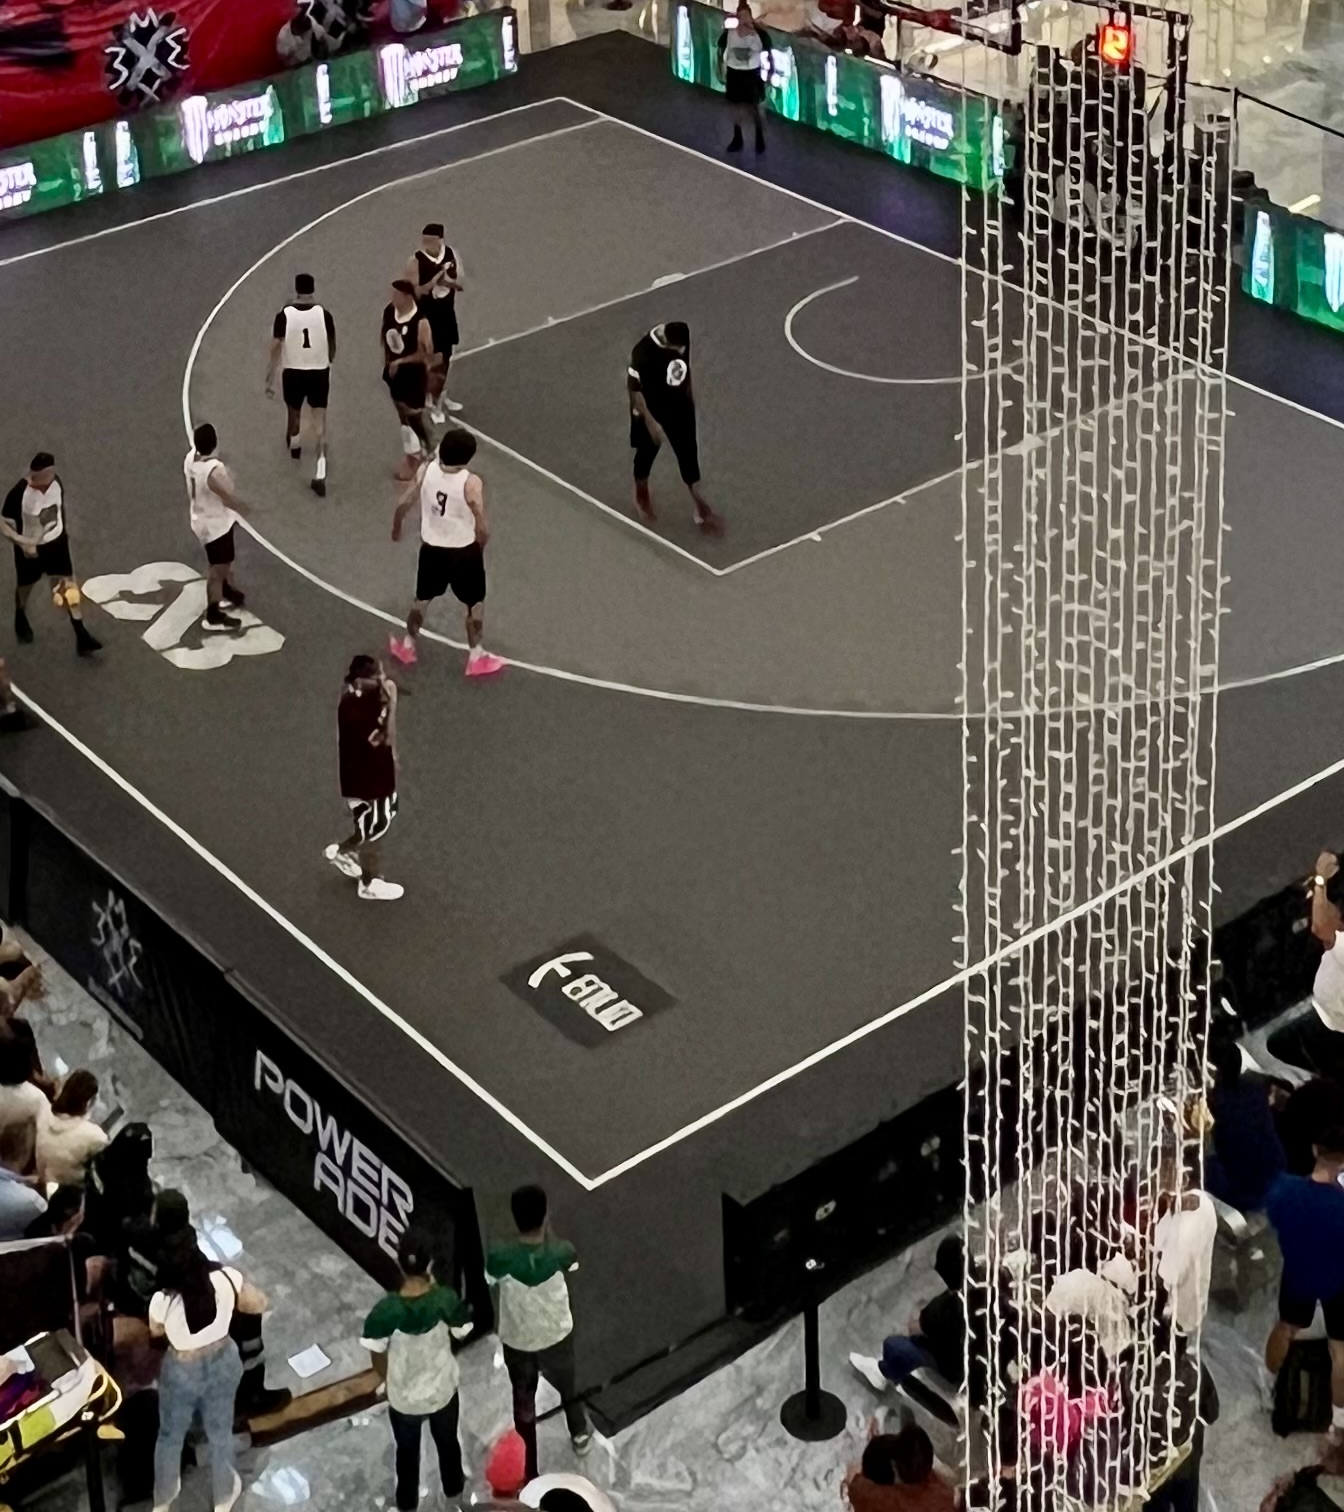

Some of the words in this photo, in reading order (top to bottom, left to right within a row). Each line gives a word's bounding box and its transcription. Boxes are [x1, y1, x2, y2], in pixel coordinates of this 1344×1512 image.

[301, 327, 312, 349] 1
[254, 1049, 414, 1228] POWER
[313, 1151, 406, 1262] ADE
